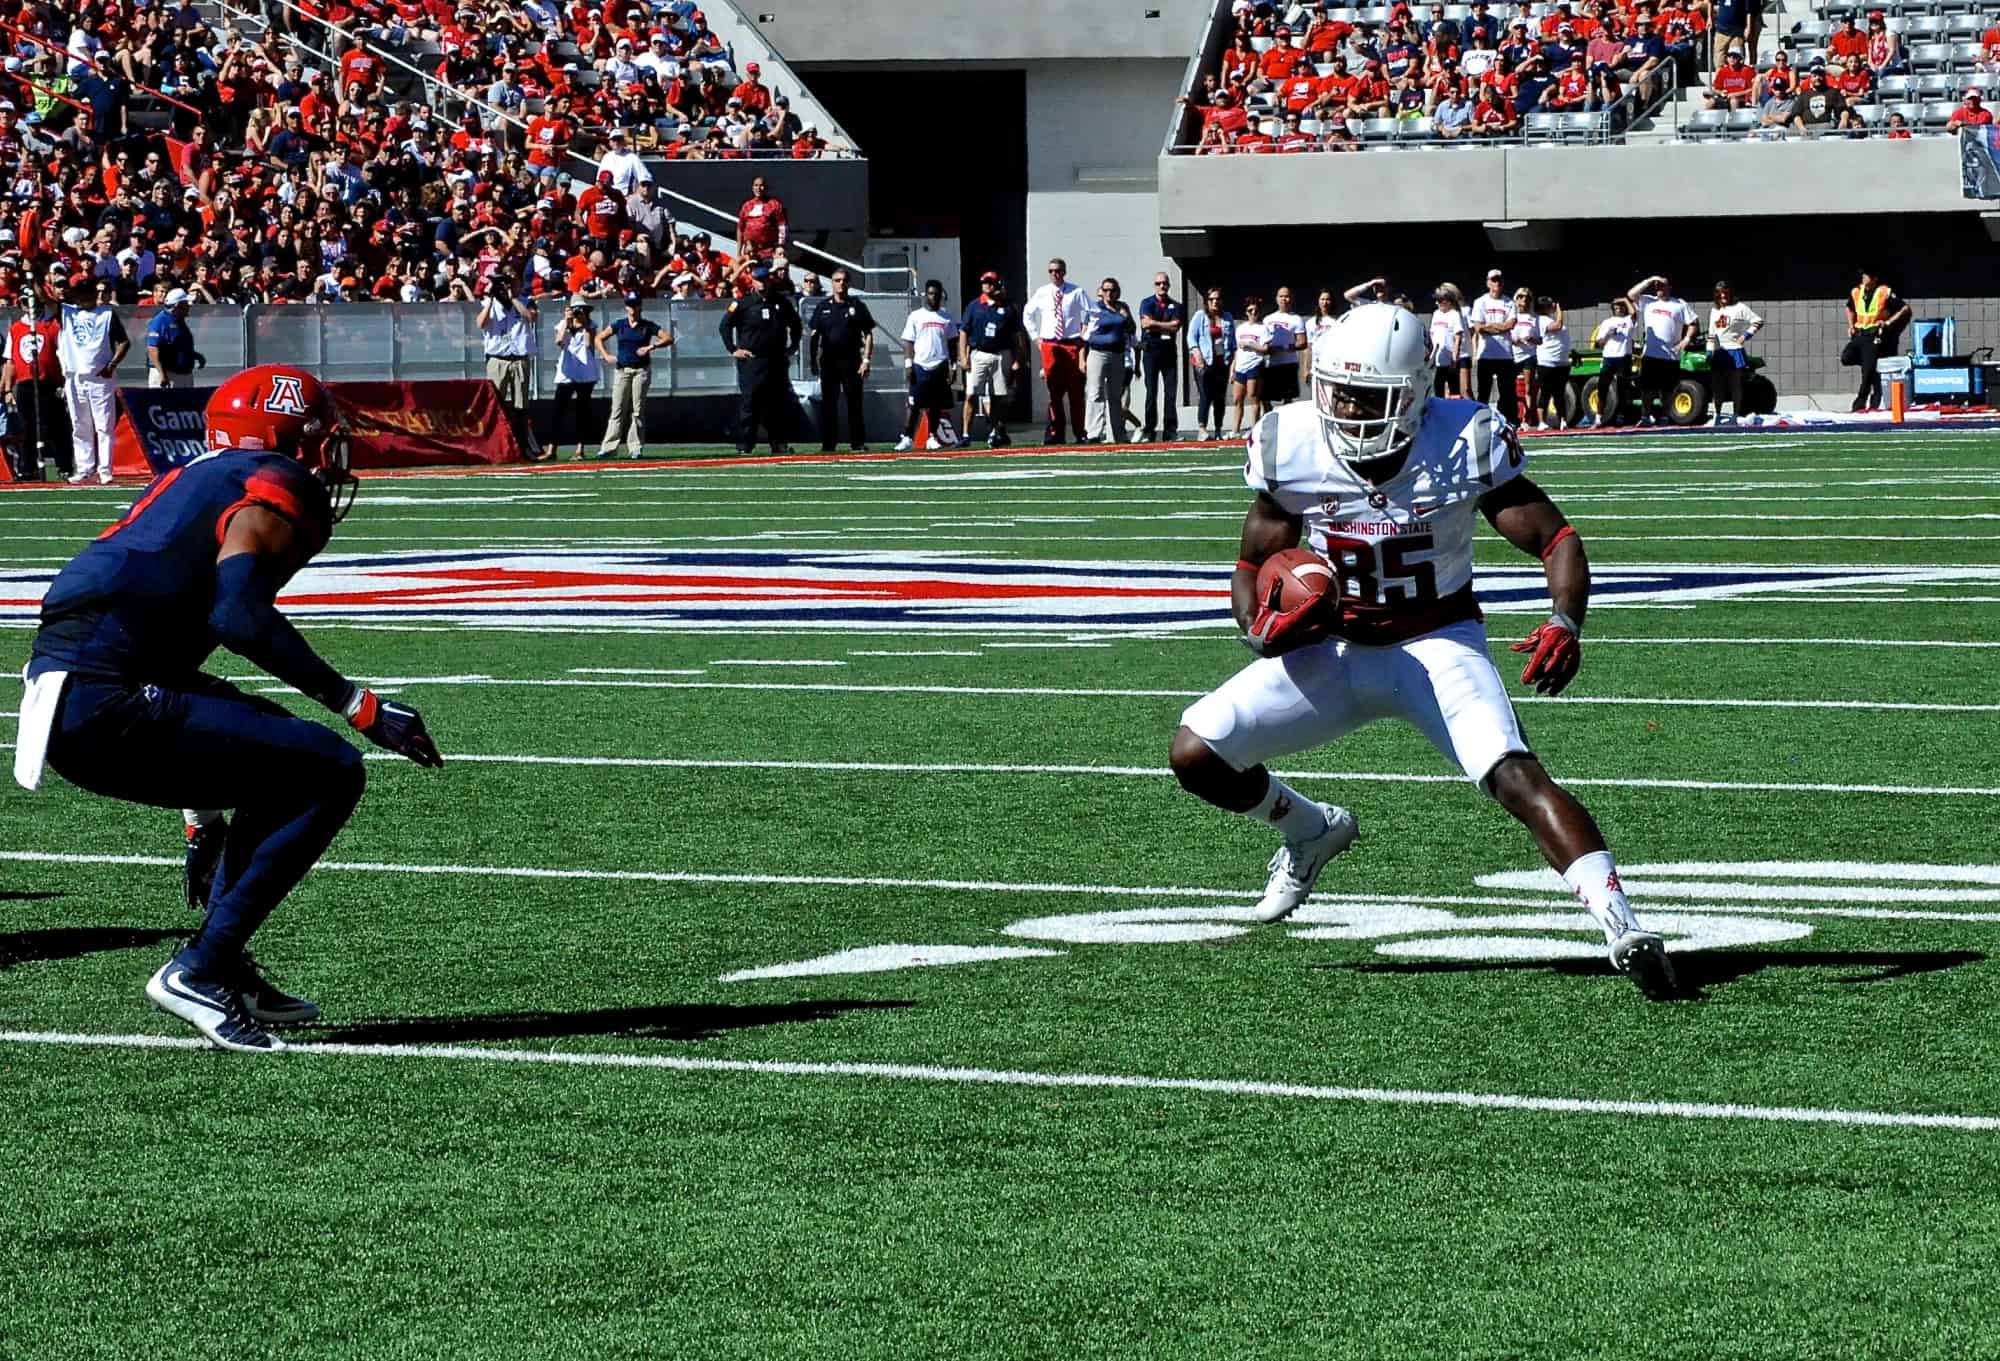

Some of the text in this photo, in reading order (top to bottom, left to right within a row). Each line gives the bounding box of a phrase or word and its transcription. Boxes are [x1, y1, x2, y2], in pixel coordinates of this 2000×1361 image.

[263, 374, 305, 416] A
[148, 405, 208, 430] Gam
[1400, 521, 1433, 534] STATE
[1327, 535, 1436, 607] 85
